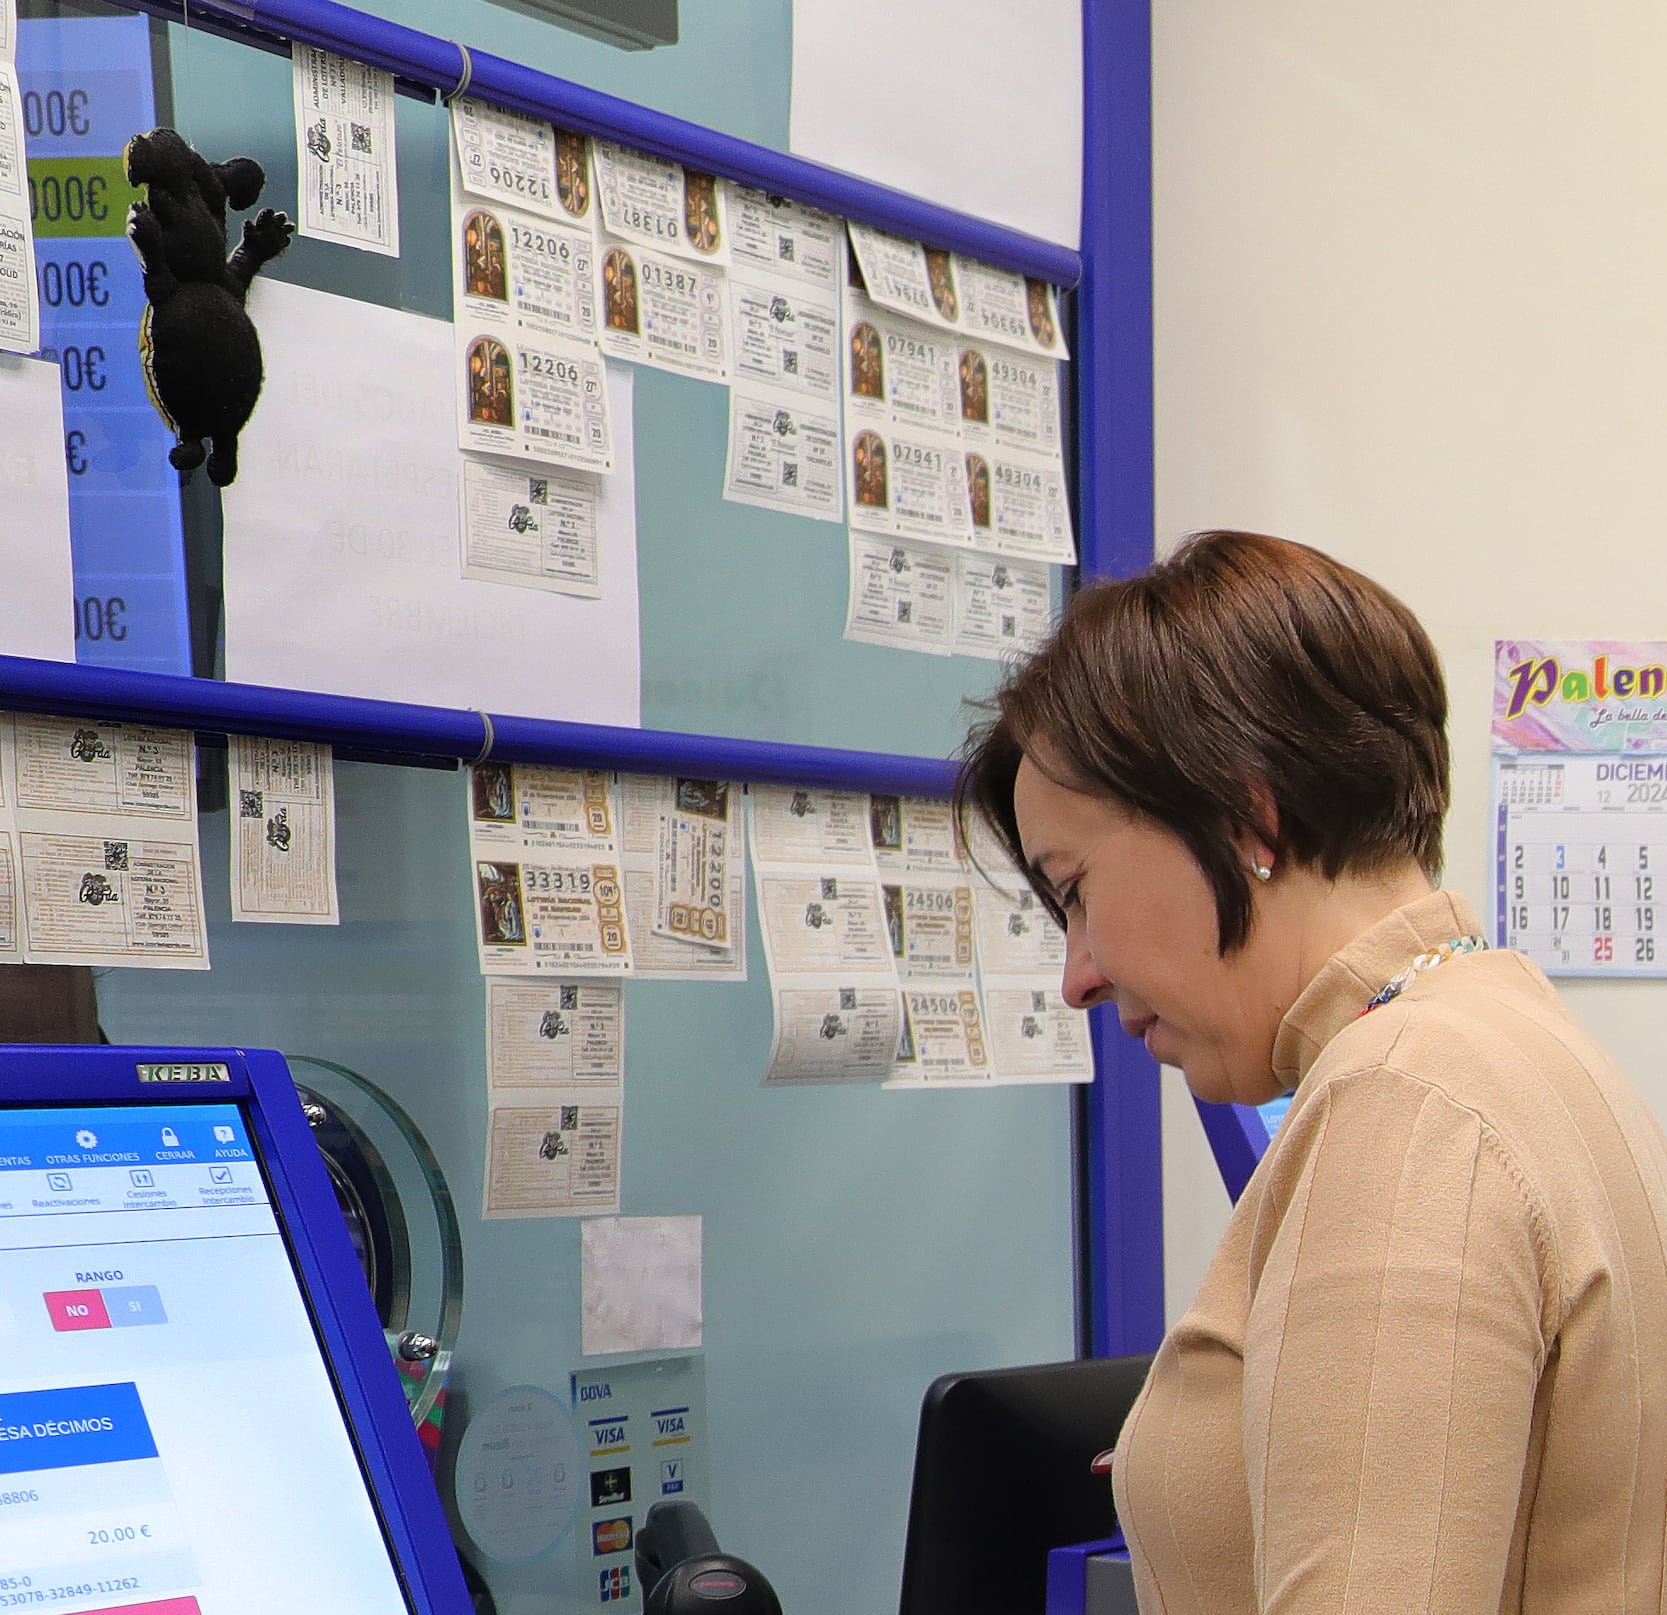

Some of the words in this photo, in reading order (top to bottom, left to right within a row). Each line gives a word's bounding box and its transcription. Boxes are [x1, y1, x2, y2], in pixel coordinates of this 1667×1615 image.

[512, 227, 569, 258] 12206
[642, 264, 697, 294] 01387
[888, 337, 935, 365] 07941
[520, 352, 578, 381] 12206
[992, 362, 1037, 386] 49304
[893, 445, 943, 472] 07941
[995, 466, 1041, 489] 49304
[1590, 708, 1613, 728] La
[1618, 708, 1648, 721] bella
[1598, 791, 1610, 802] 12
[1515, 846, 1523, 869] 2
[1556, 846, 1564, 869] 3
[1598, 846, 1606, 869] 4
[1639, 846, 1648, 869] 5
[708, 830, 722, 908] 12200
[526, 871, 591, 890] 33319
[1515, 876, 1523, 900] 9
[1553, 876, 1569, 900] 10
[1595, 876, 1610, 900] 11
[1636, 876, 1652, 900] 12
[908, 892, 953, 909] 24506
[1512, 907, 1527, 930] 16
[1553, 907, 1569, 930] 17
[1595, 907, 1611, 931] 18
[1636, 908, 1653, 931] 19
[1594, 937, 1612, 961] 25
[1636, 938, 1653, 961] 26
[150, 1065, 221, 1081] KEBA
[46, 1154, 80, 1164] OTRAS
[83, 1152, 140, 1163] FUNCIONES
[156, 1151, 195, 1161] CERRAR
[215, 1149, 248, 1158] AYUDA
[127, 1190, 167, 1199] Cesiones
[199, 1186, 252, 1196] Recepciones
[33, 1197, 100, 1208] Reactivaciones
[123, 1199, 176, 1208] Intercambio
[76, 1270, 123, 1283] RANGO
[66, 1305, 88, 1316] NO
[128, 1302, 141, 1312] SI
[34, 1417, 113, 1437] DÉCIMOS
[658, 1417, 684, 1435] VISA
[596, 1428, 625, 1445] VISA
[88, 1526, 135, 1544] 20,00
[140, 1525, 151, 1537] €
